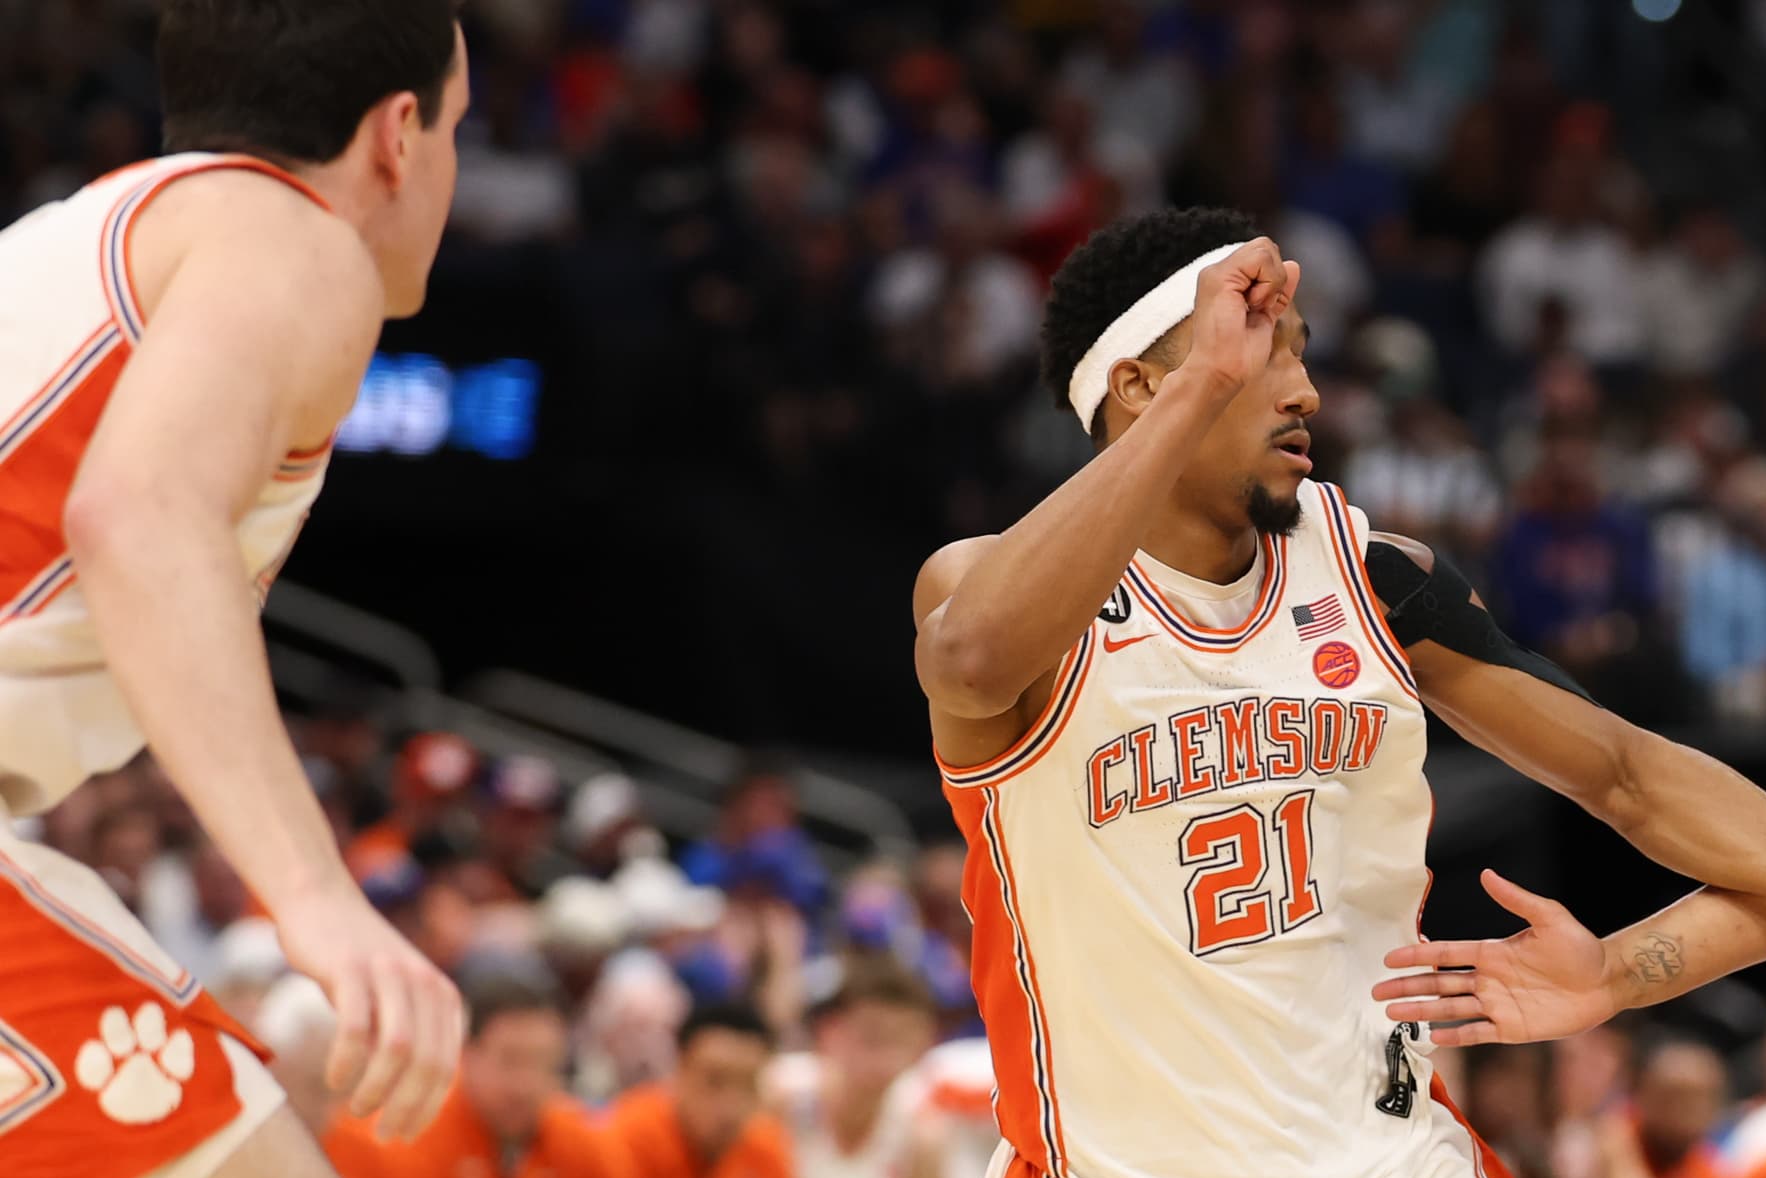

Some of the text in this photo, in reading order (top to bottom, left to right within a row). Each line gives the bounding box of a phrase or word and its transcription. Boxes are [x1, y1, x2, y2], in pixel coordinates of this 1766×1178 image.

[1321, 652, 1352, 672] ACC
[1087, 697, 1387, 829] CLEMSON
[1178, 788, 1323, 958] 21
